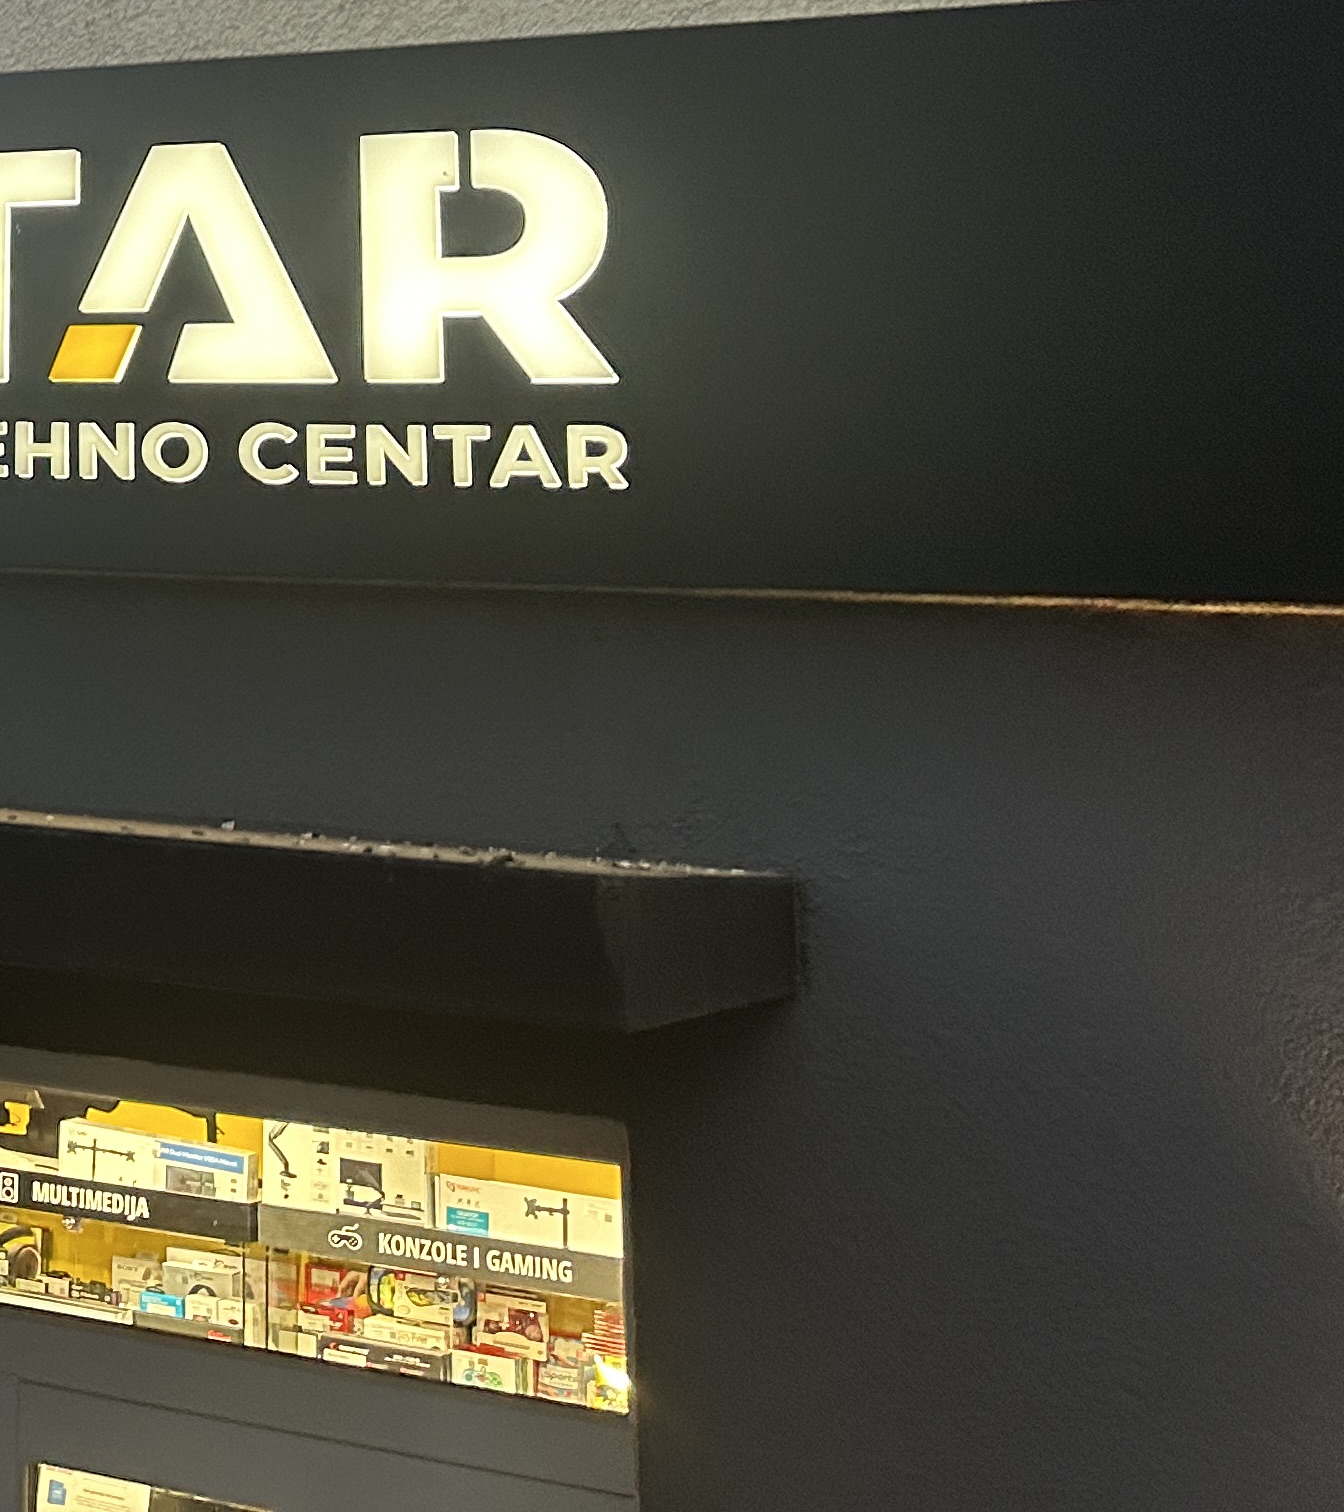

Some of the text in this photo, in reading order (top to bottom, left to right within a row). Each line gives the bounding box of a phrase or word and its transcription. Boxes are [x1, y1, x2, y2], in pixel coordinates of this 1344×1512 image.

[237, 422, 630, 489] CENTAR
[32, 1180, 150, 1221] MULTIMEDIJA
[378, 1232, 468, 1267] KONZOLE
[486, 1249, 573, 1283] GAMING
